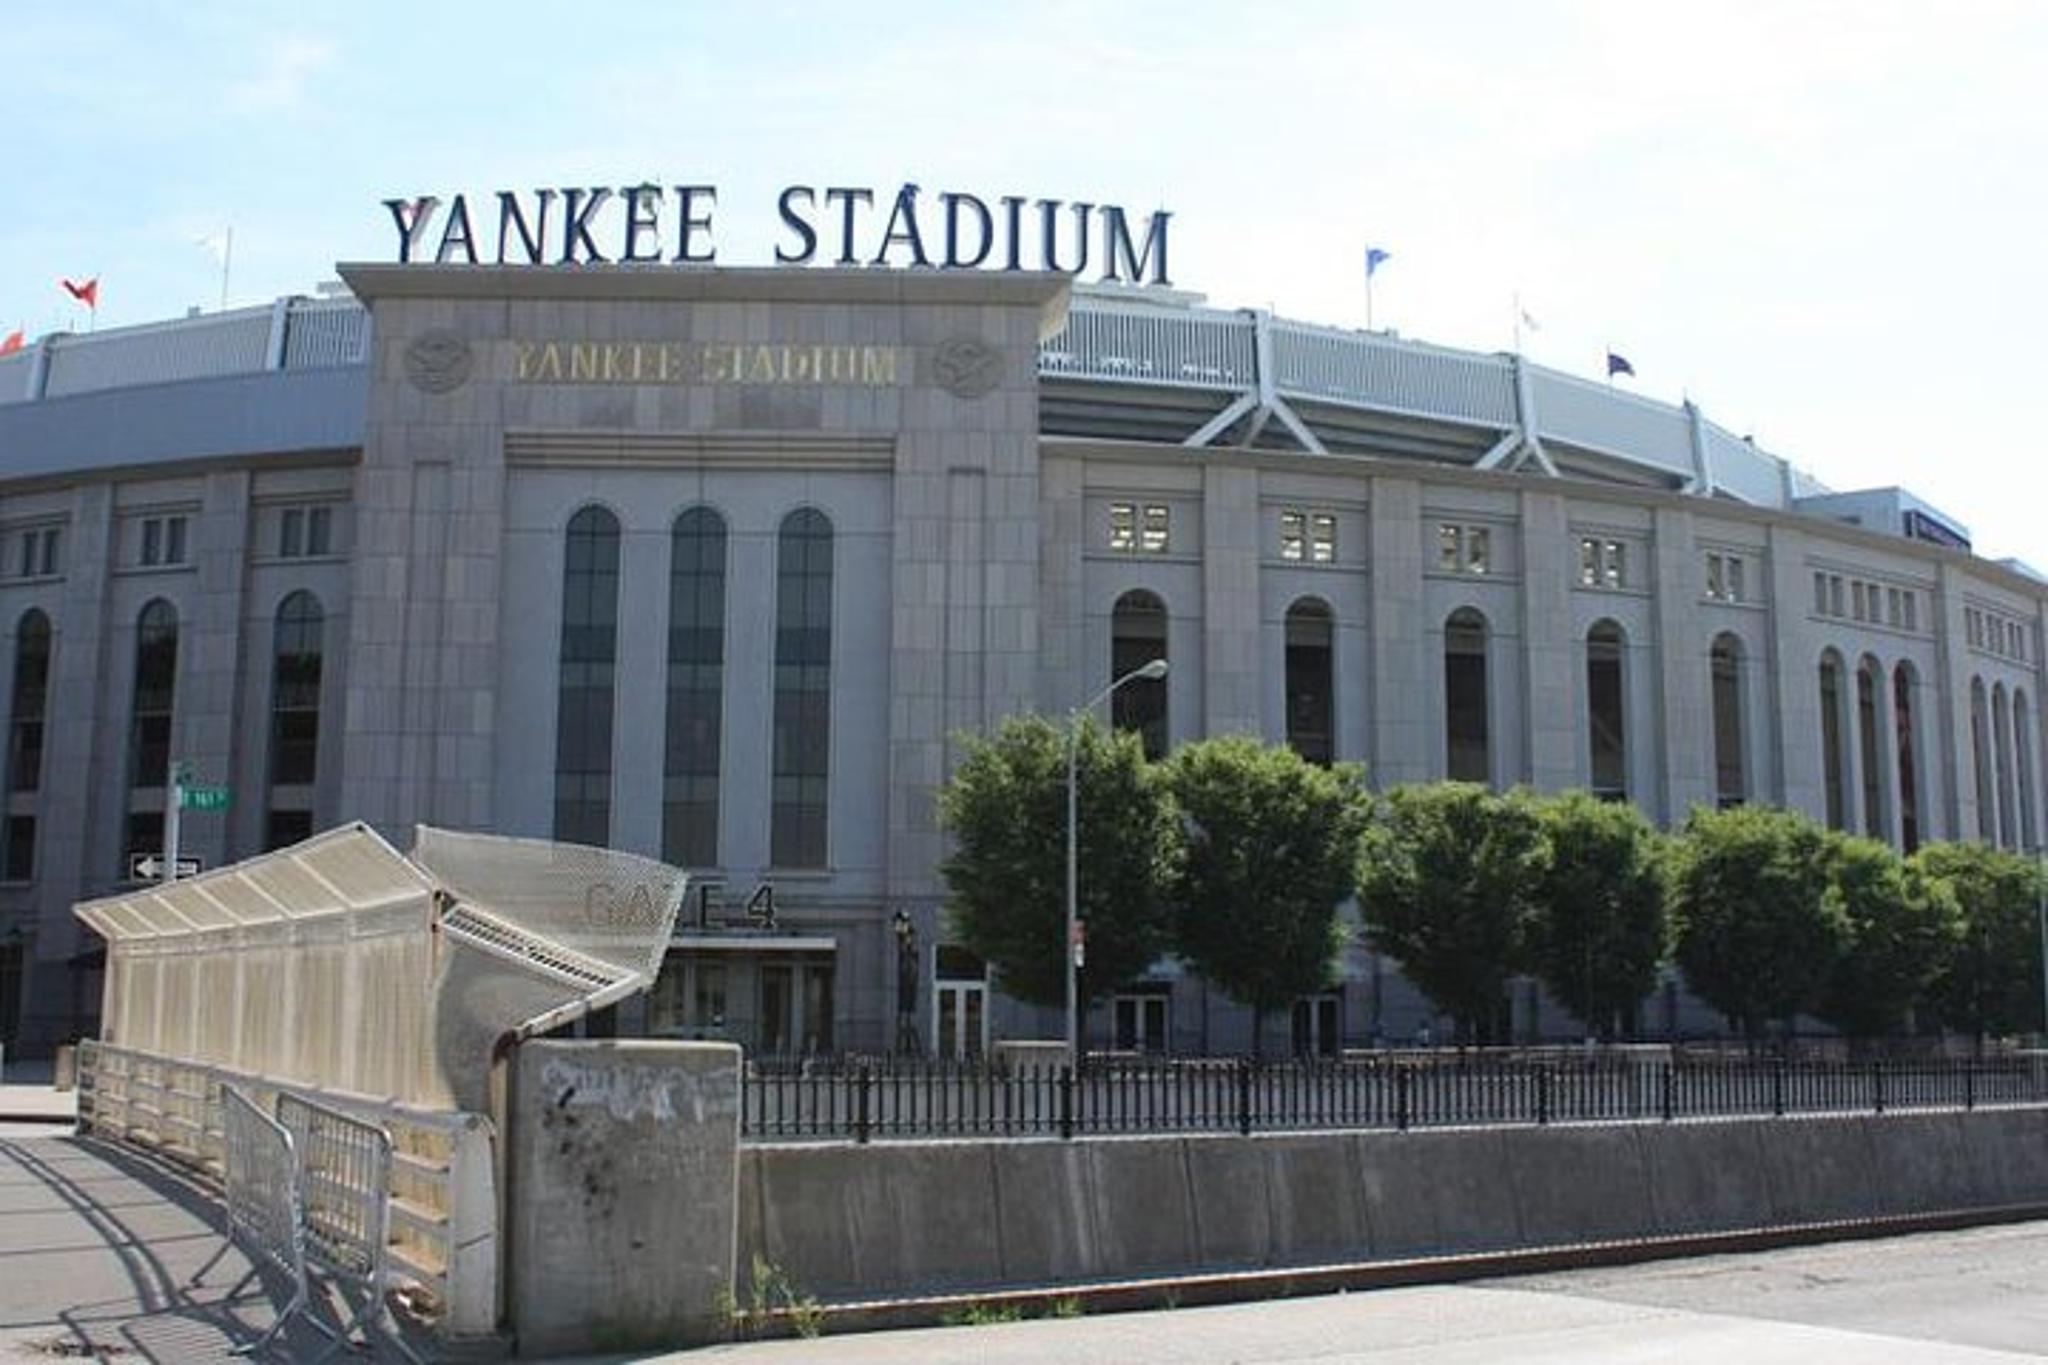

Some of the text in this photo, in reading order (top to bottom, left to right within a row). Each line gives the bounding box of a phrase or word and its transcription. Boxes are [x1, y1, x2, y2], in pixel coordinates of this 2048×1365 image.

[382, 185, 1173, 286] YANKEE STADIUM
[514, 340, 898, 385] YANKEE STADIUM
[747, 882, 777, 930] 4
